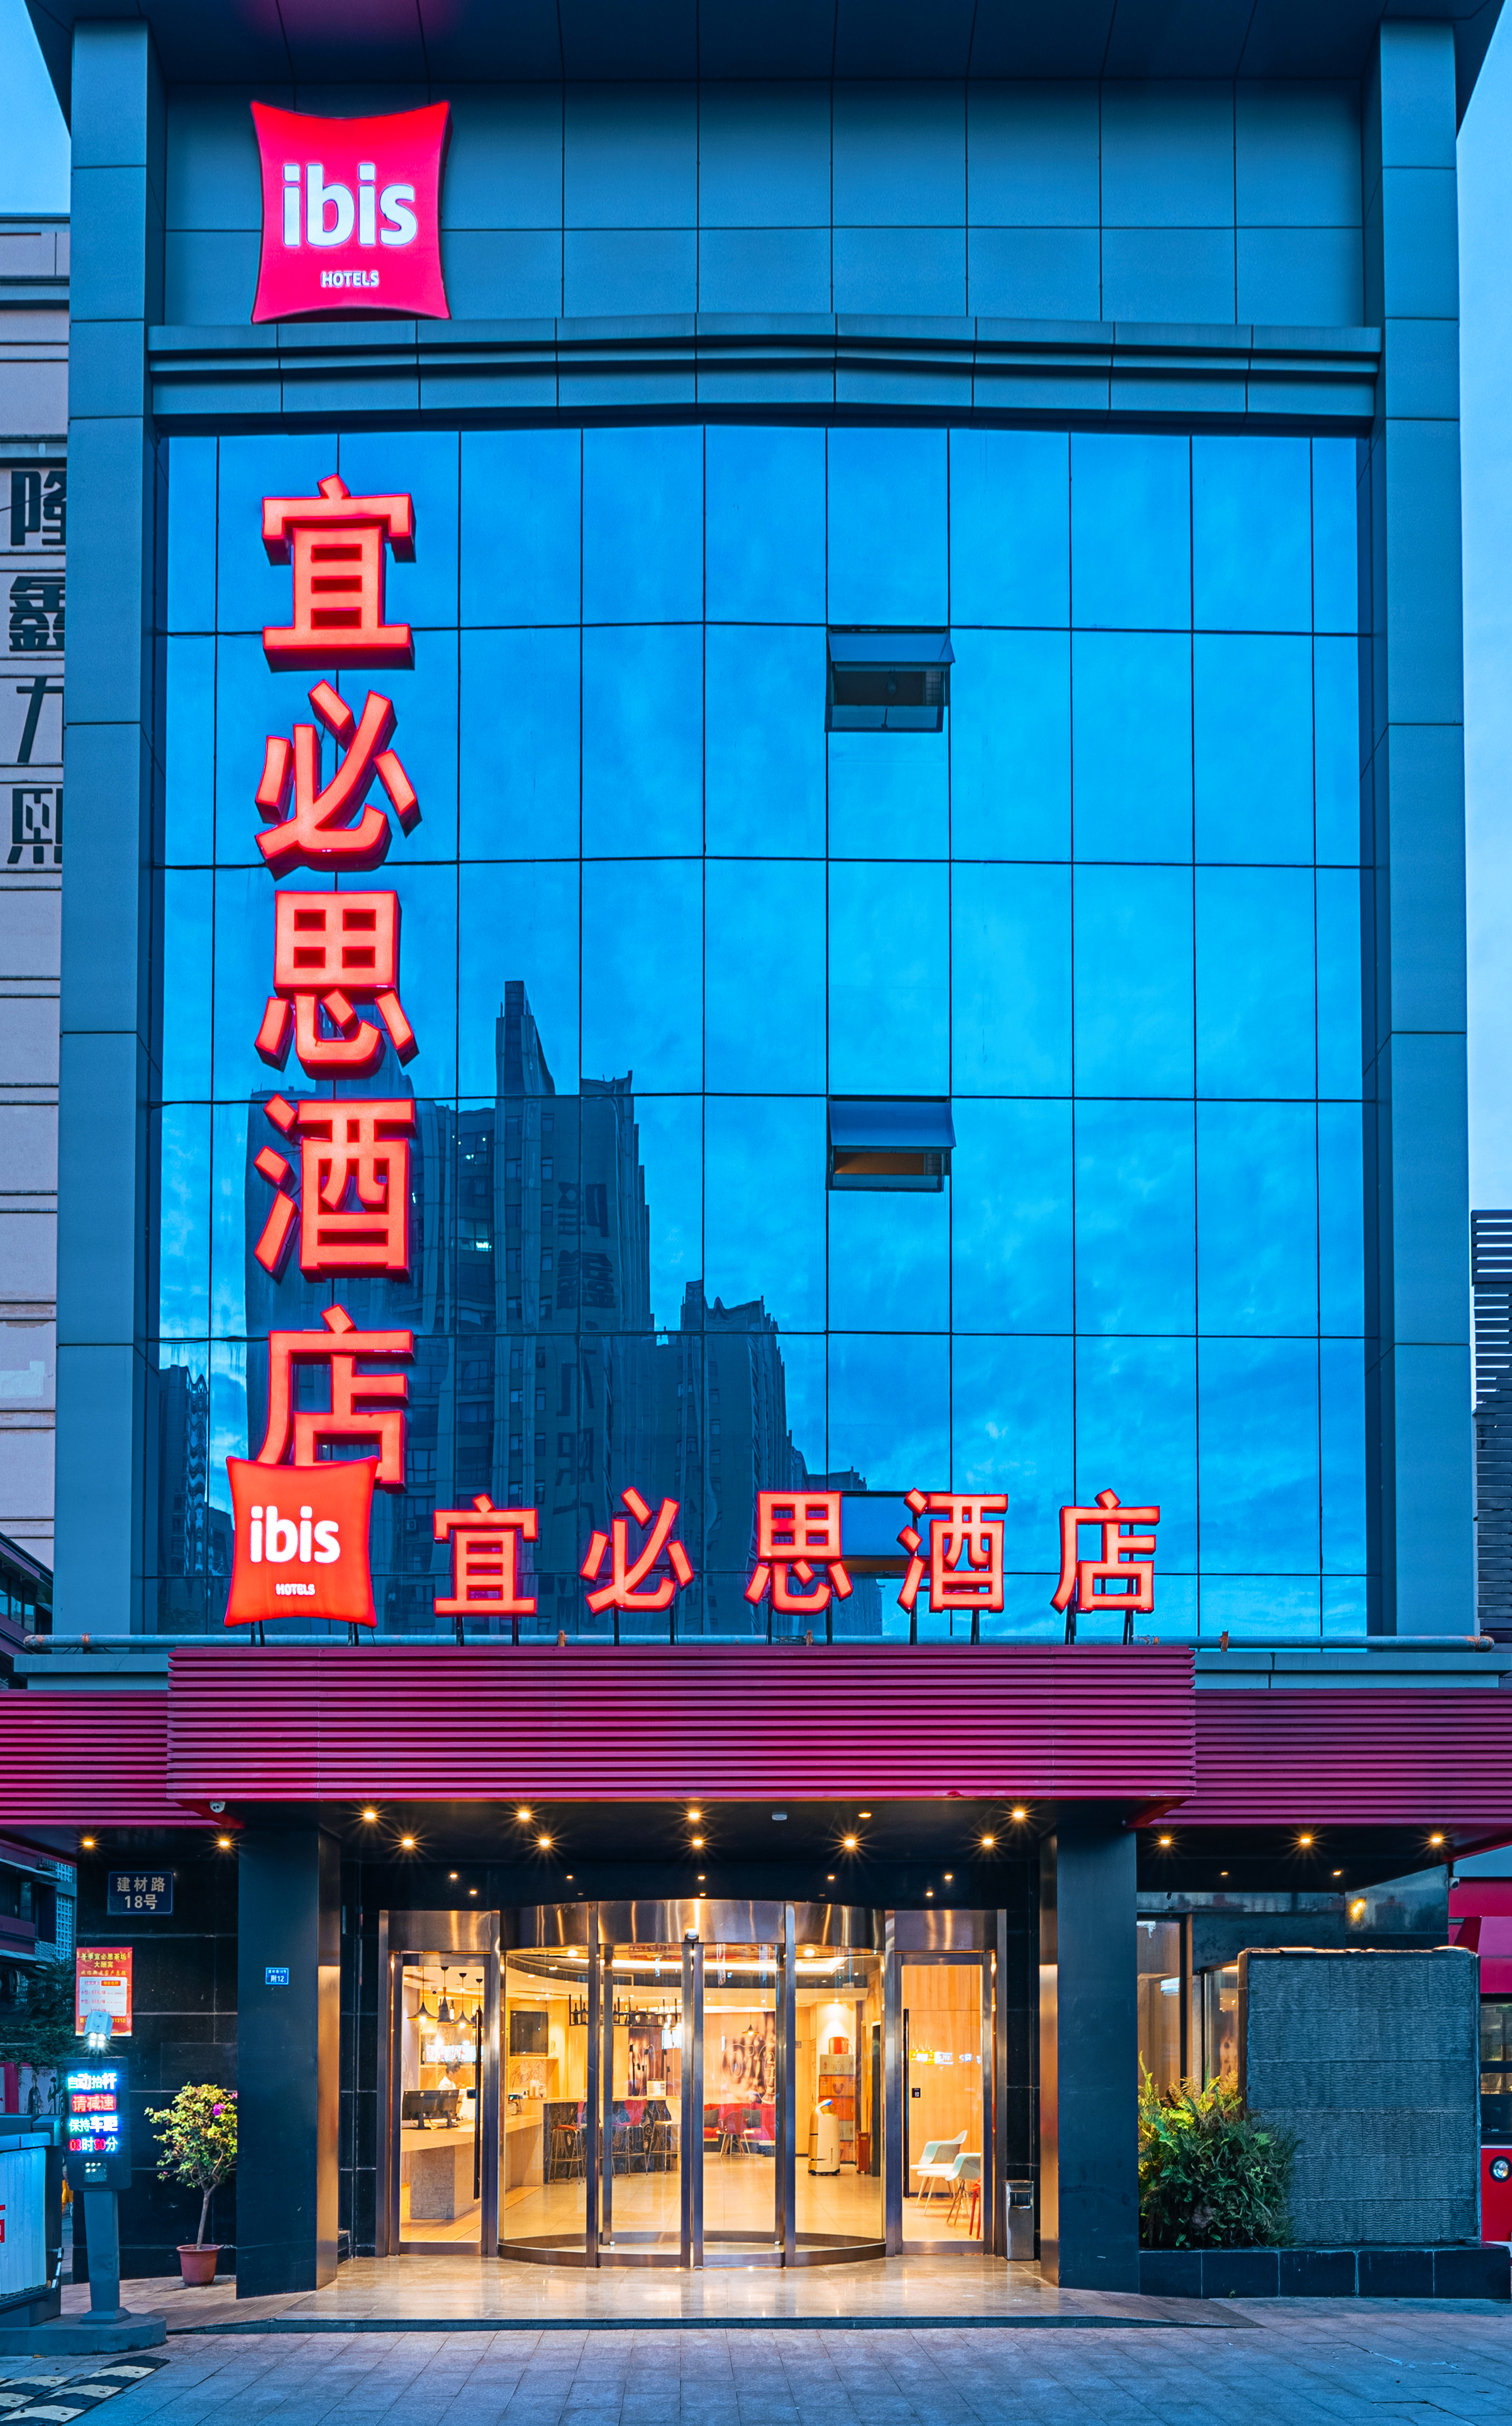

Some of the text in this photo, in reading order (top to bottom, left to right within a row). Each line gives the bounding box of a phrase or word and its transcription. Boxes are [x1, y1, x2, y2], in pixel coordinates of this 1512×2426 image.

[283, 163, 418, 247] ibis
[321, 271, 379, 287] HOTELS
[255, 472, 420, 1492] 宜必思酒店
[250, 1505, 340, 1564] ibis
[433, 1486, 1160, 1618] 宜必思酒店
[275, 1583, 316, 1596] HOTELS
[117, 1876, 165, 1893] 建材路
[125, 1894, 158, 1910] 18号
[270, 1974, 284, 1983] 附12
[68, 2072, 117, 2090] 自动抬杆
[72, 2095, 116, 2112] 请减速
[69, 2115, 118, 2133] 保持车距
